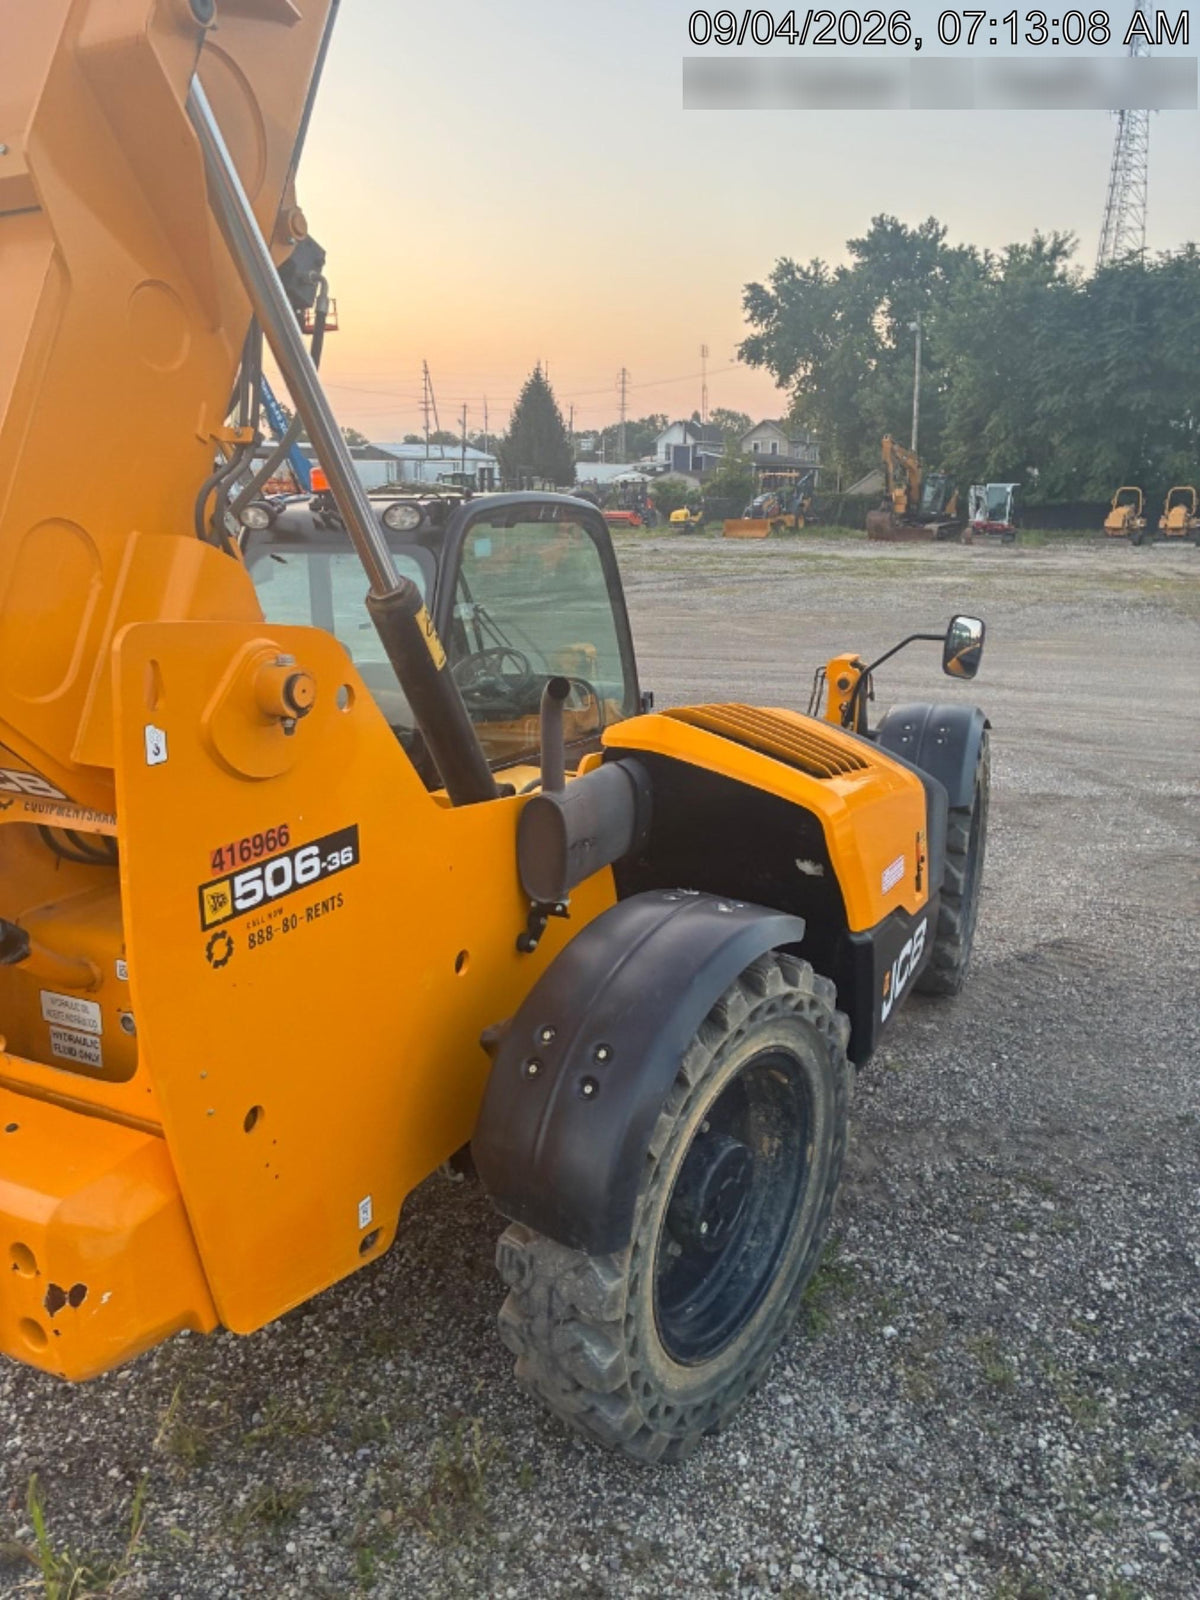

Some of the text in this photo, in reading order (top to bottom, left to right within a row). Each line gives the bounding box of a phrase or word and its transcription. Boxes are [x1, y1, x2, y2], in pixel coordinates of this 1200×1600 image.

[211, 823, 290, 872] 416966
[248, 892, 344, 949] 888-80-RENTS
[881, 917, 927, 1023] JCB
